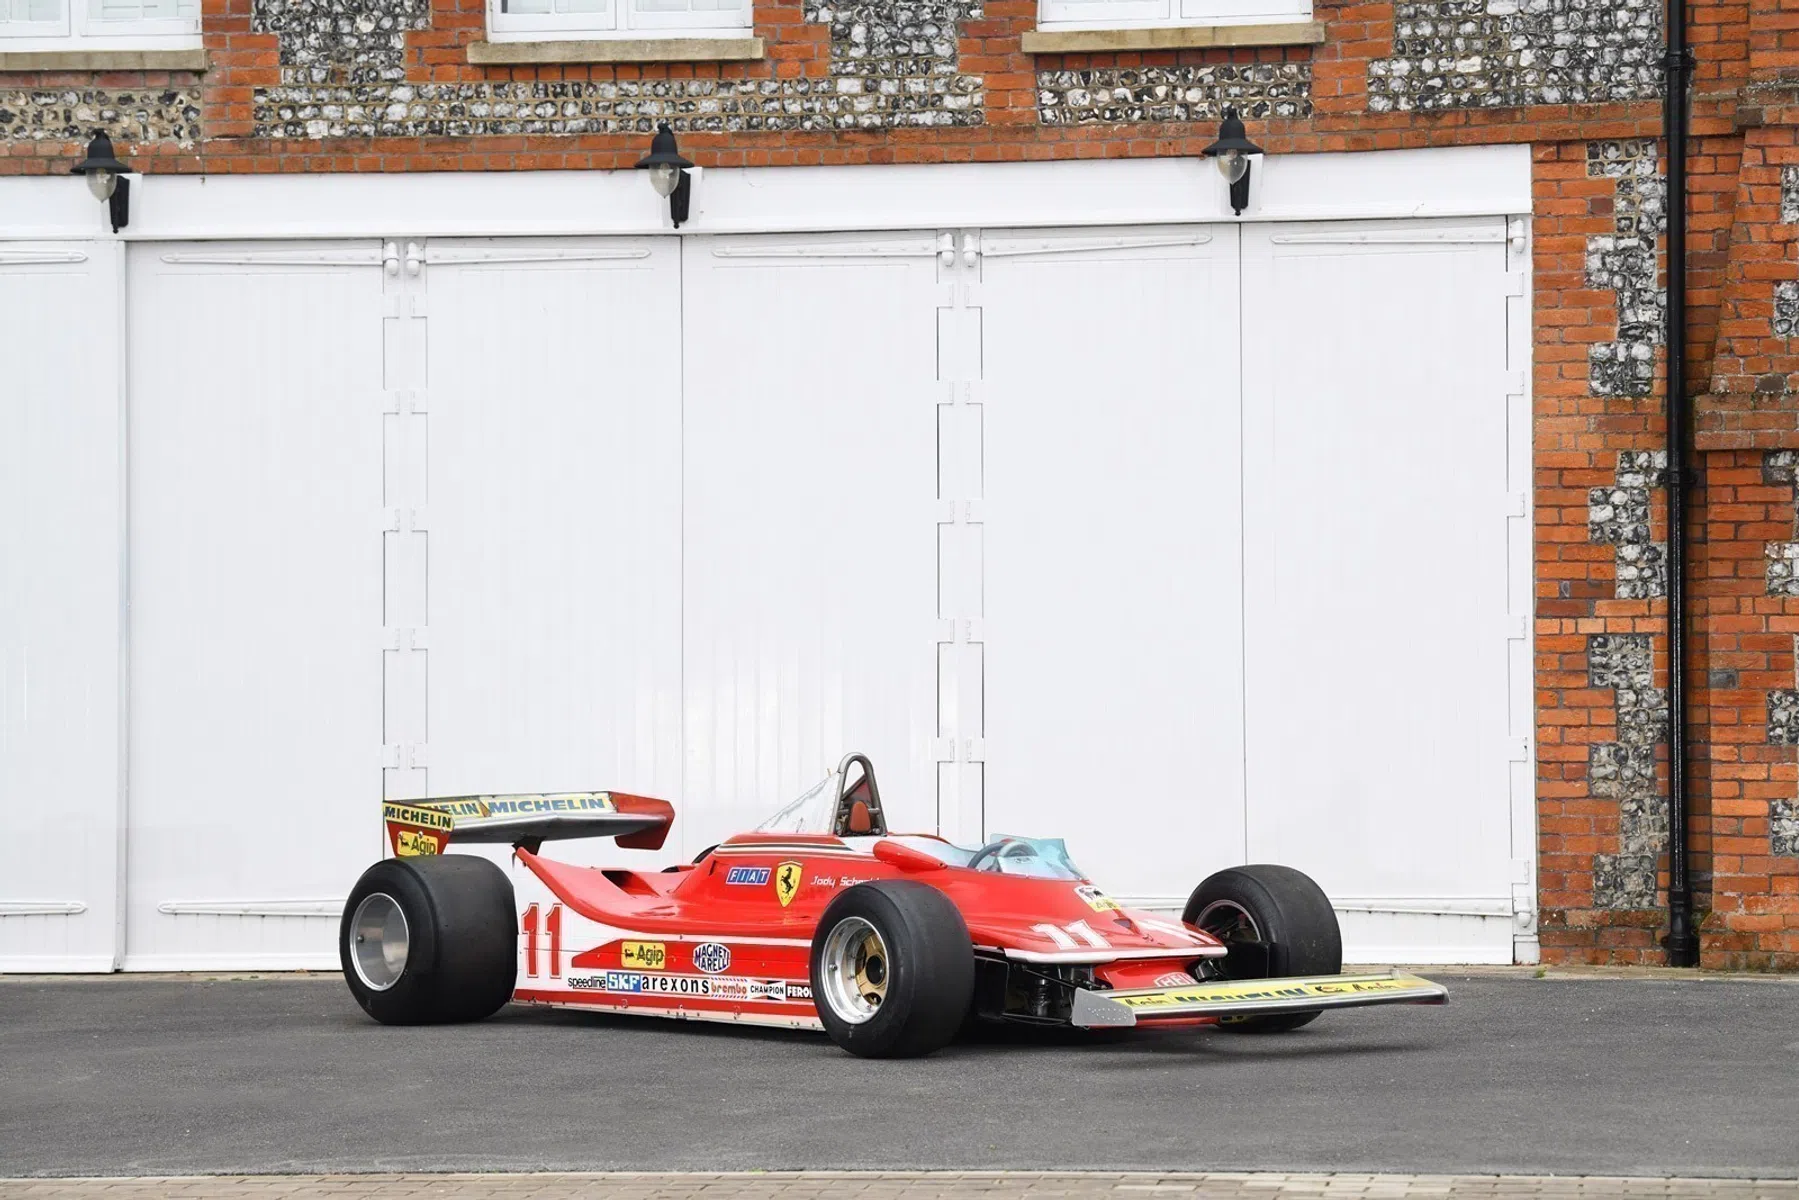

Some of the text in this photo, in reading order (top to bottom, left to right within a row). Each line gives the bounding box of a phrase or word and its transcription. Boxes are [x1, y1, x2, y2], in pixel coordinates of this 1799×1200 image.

[487, 798, 606, 814] MICHELIN
[384, 806, 451, 828] MICHELIN
[728, 868, 769, 883] FIAT
[810, 875, 836, 888] Jody
[521, 902, 562, 979] 11
[1028, 918, 1113, 950] 11
[636, 944, 664, 966] Agip
[694, 943, 730, 959] MAGNETI
[694, 956, 730, 972] MARELLI
[568, 975, 606, 989] speedline
[607, 973, 641, 991] SKF
[641, 976, 709, 994] arexons
[711, 981, 748, 995] brembo
[750, 985, 784, 995] CHAMPION
[787, 985, 813, 998] FERO
